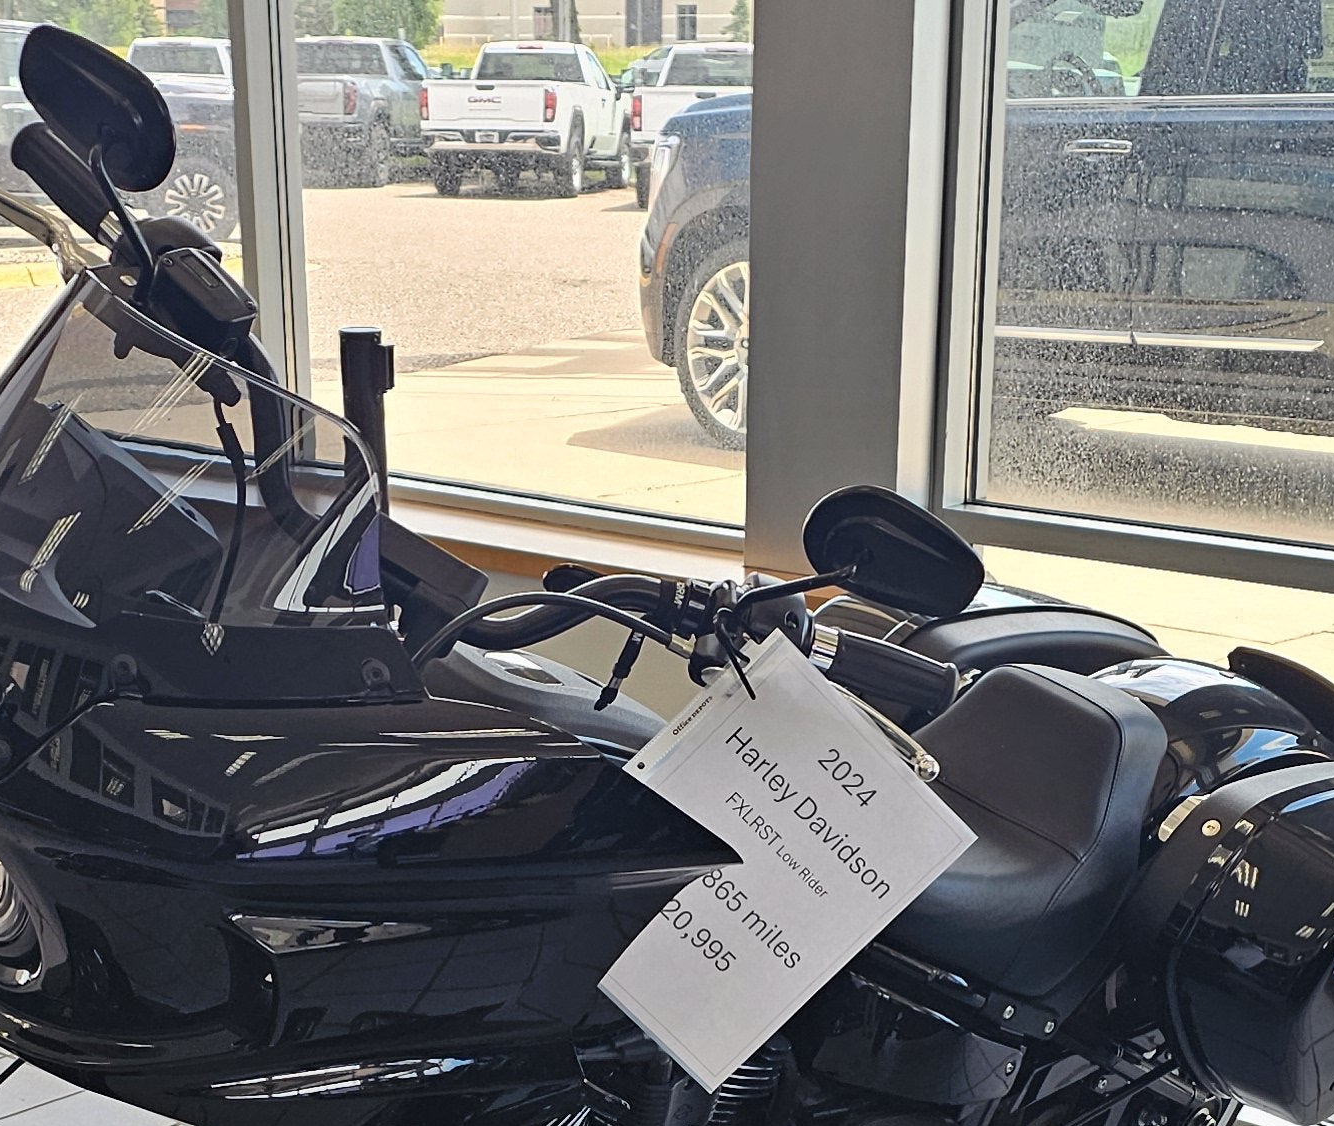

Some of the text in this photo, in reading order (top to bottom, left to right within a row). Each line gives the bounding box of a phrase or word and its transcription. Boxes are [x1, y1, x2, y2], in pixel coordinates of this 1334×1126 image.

[672, 717, 692, 735] Office
[817, 748, 877, 807] 2024
[725, 726, 891, 900] Harley Davidson
[725, 791, 828, 898] FXLRST Low Rider
[660, 899, 737, 972] 20,995
[741, 910, 801, 969] miles
